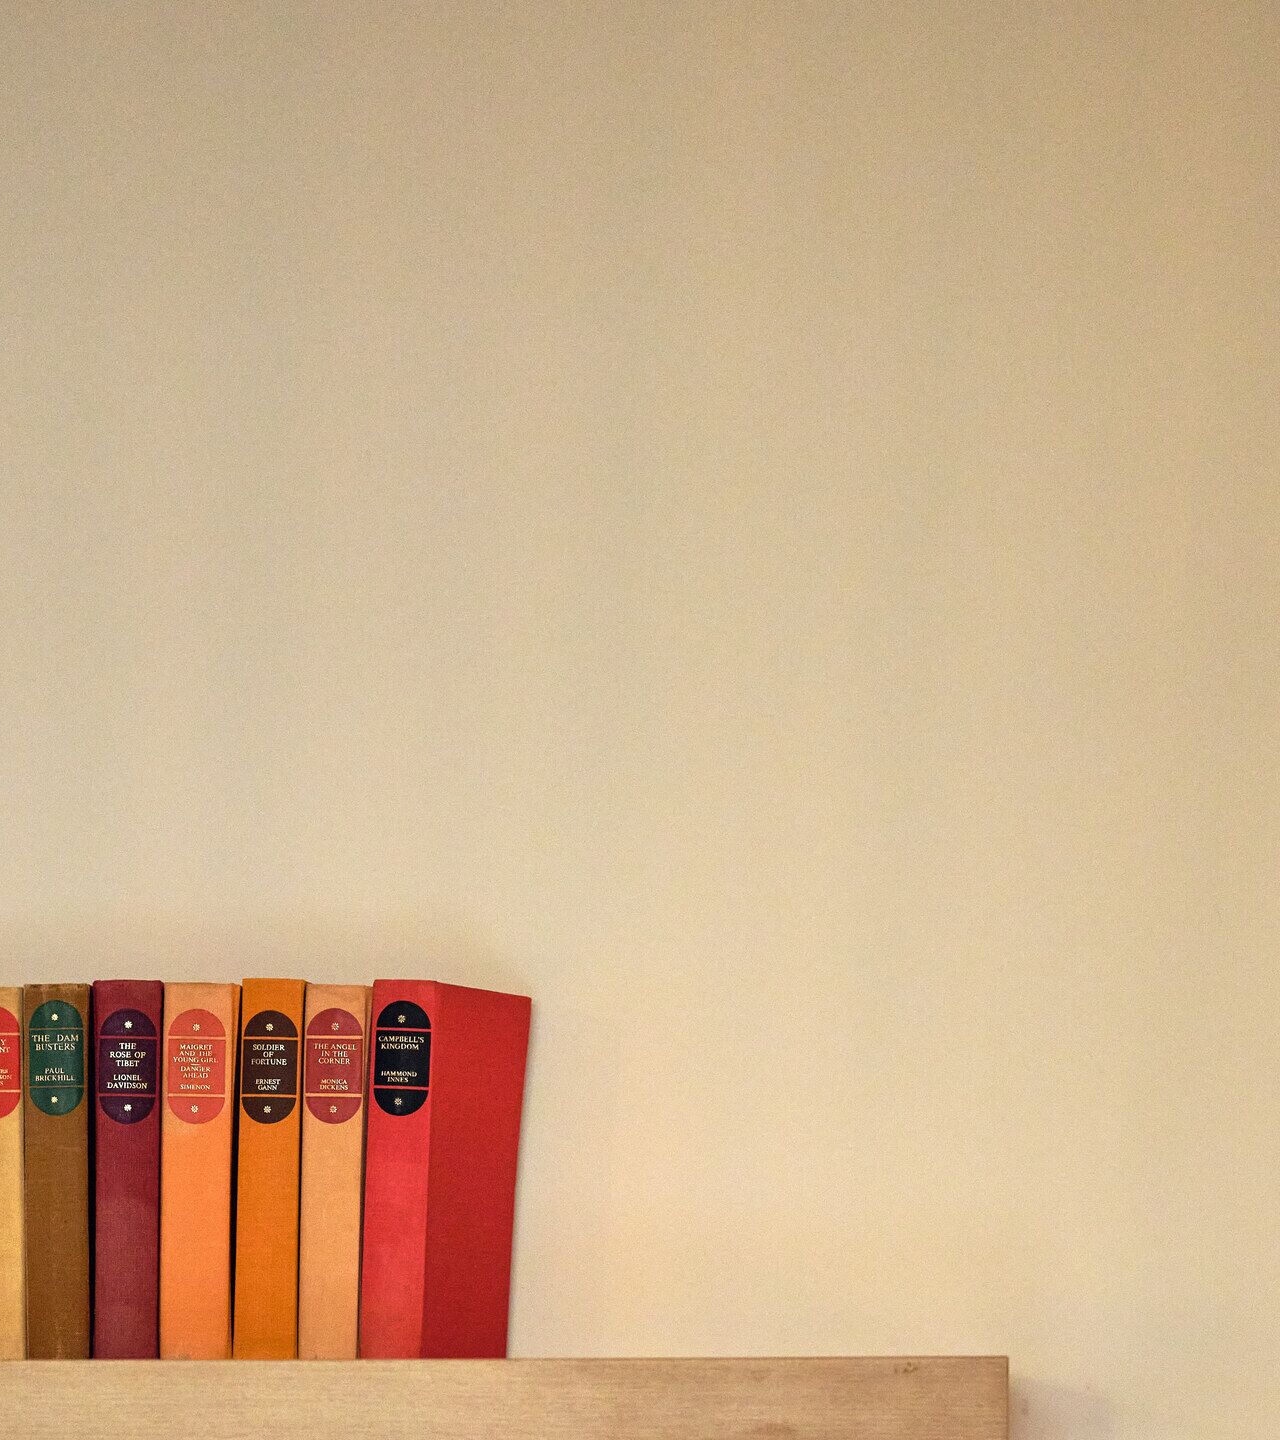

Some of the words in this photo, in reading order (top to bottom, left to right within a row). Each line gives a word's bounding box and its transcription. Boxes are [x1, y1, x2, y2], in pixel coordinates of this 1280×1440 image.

[57, 1034, 79, 1042] DAM
[36, 1043, 76, 1051] BUSTERS
[110, 1051, 131, 1059] ROSE
[134, 1051, 146, 1059] OF
